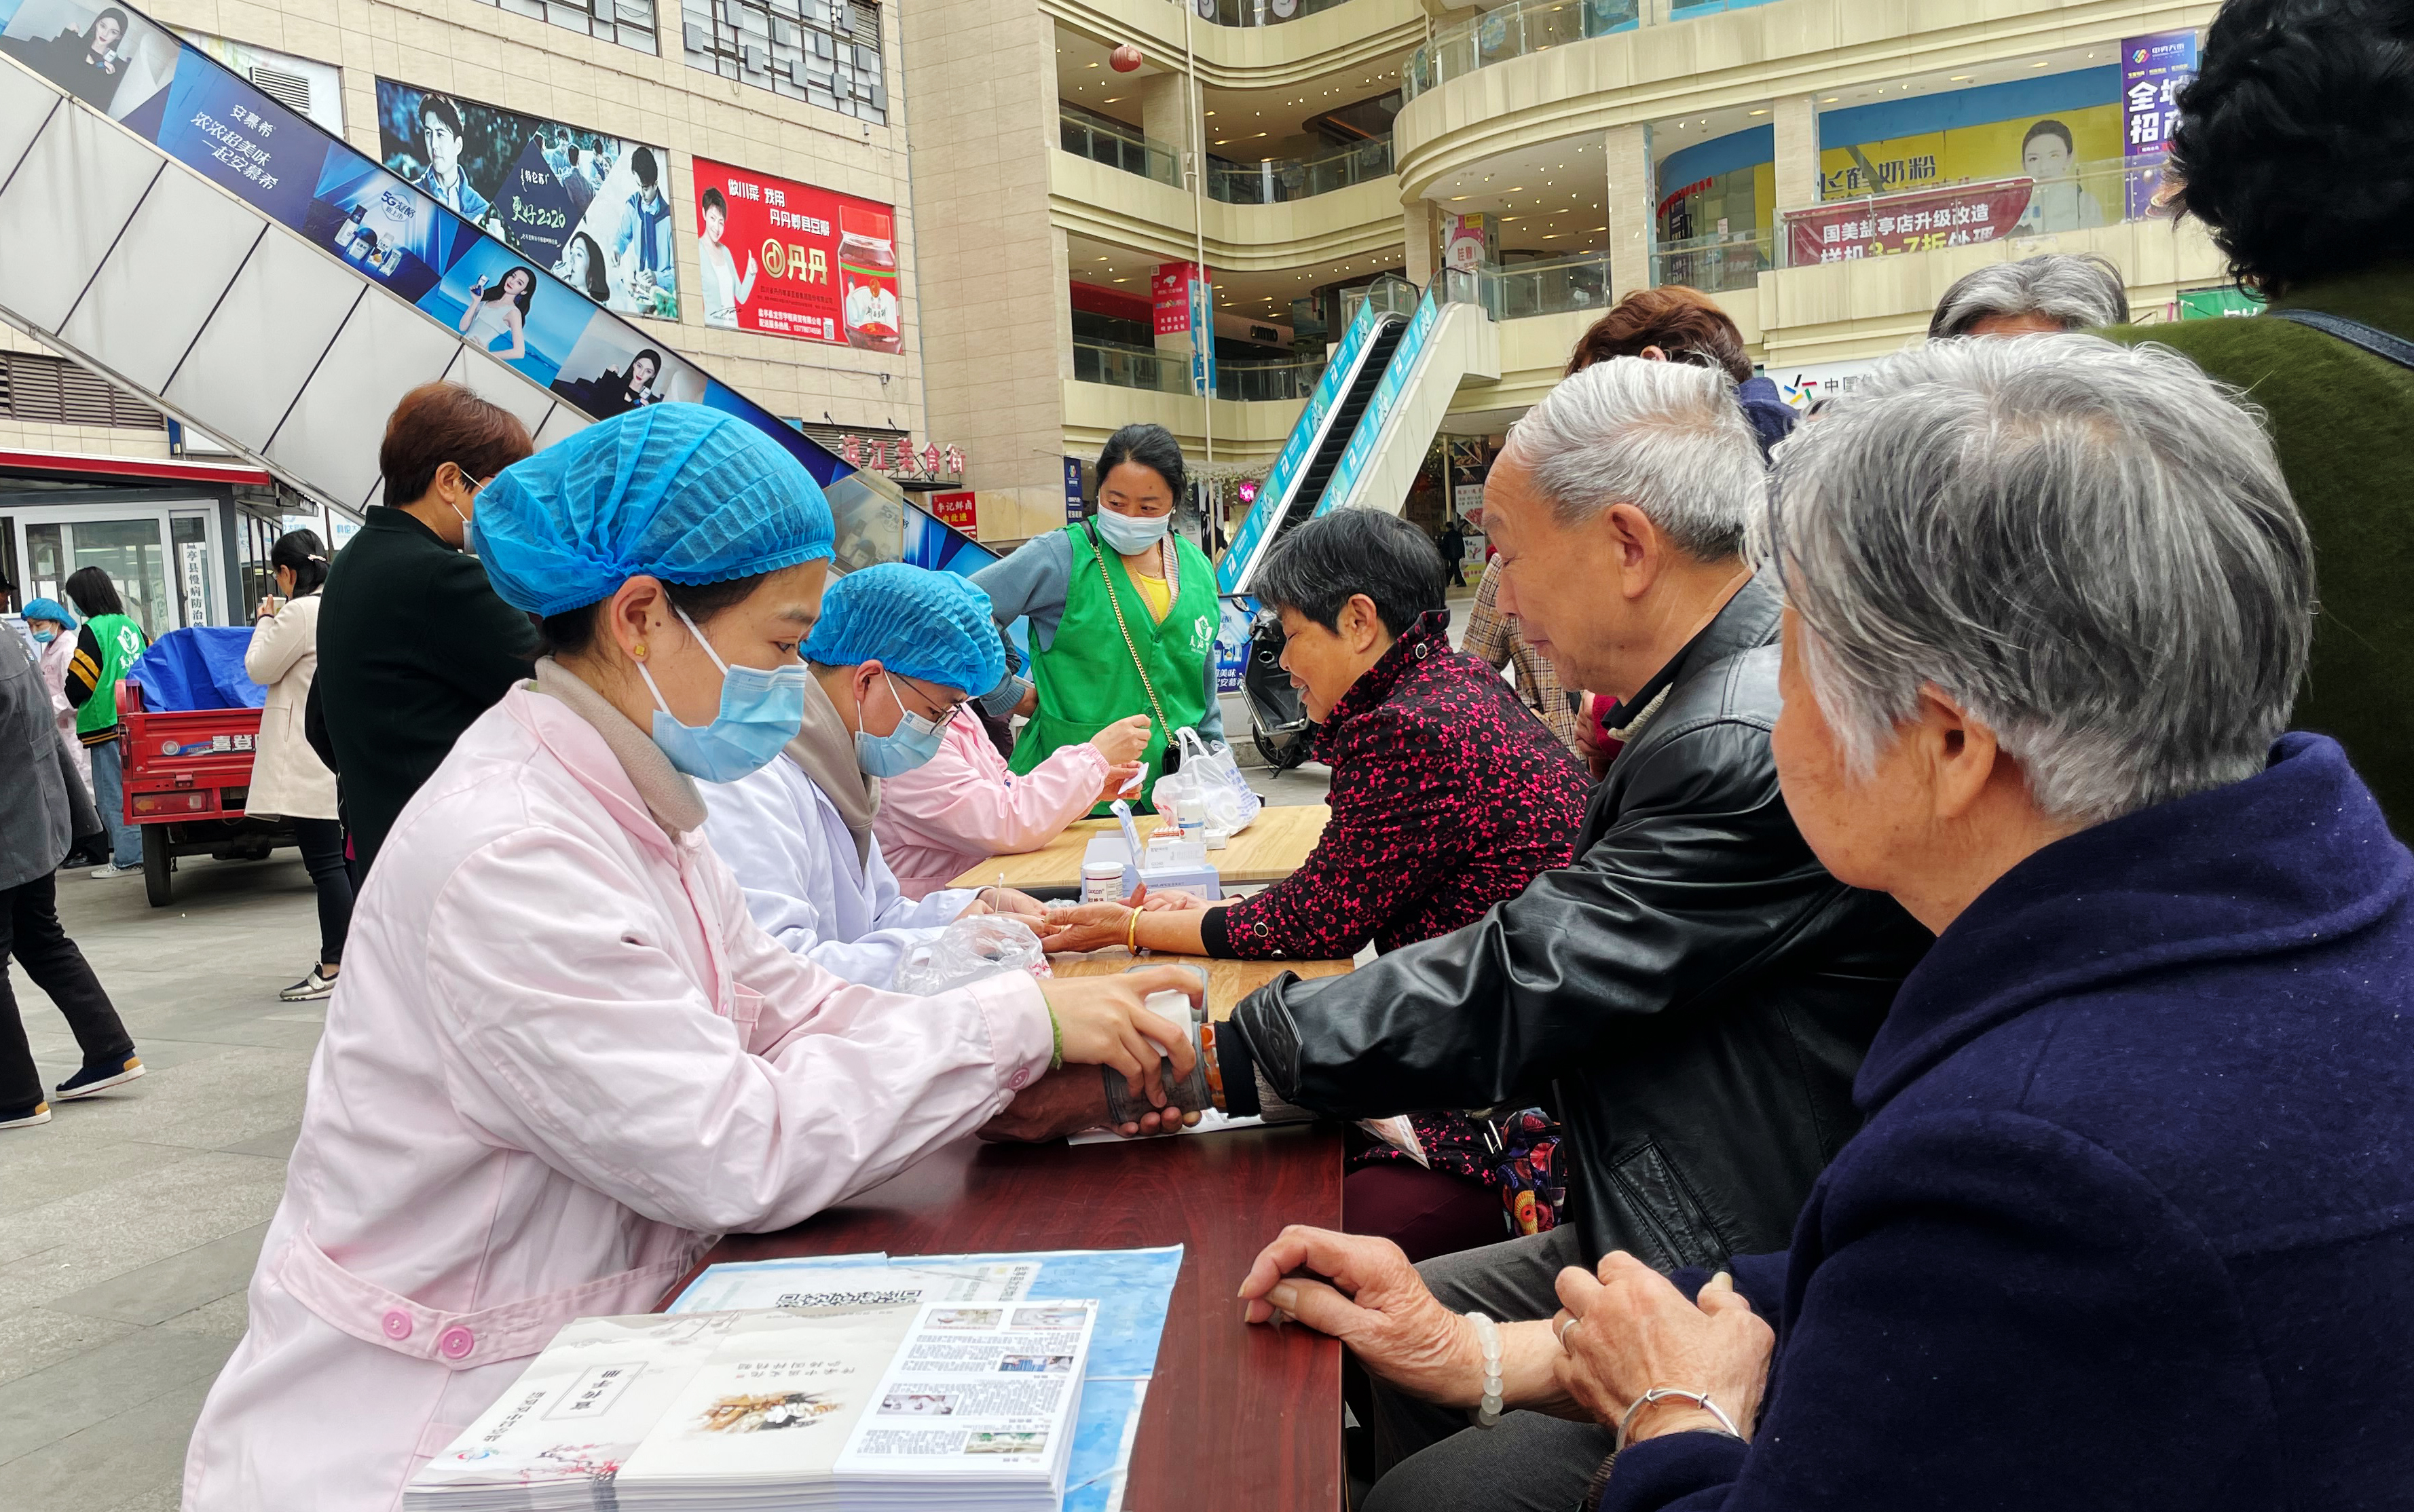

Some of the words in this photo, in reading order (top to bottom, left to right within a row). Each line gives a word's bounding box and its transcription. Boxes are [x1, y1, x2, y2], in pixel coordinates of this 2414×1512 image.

[190, 111, 272, 166] 浓浓超美味
[229, 104, 274, 138] 安慕希
[202, 139, 279, 189] 一起安慕希
[728, 178, 759, 202] 做川菜
[764, 187, 785, 208] 我用
[770, 208, 830, 236] 丹丹郫县豆瓣
[1823, 202, 1990, 244] 国美盐亭店升级改造
[787, 243, 828, 286] 丹丹
[838, 434, 967, 474] 滨江美食街
